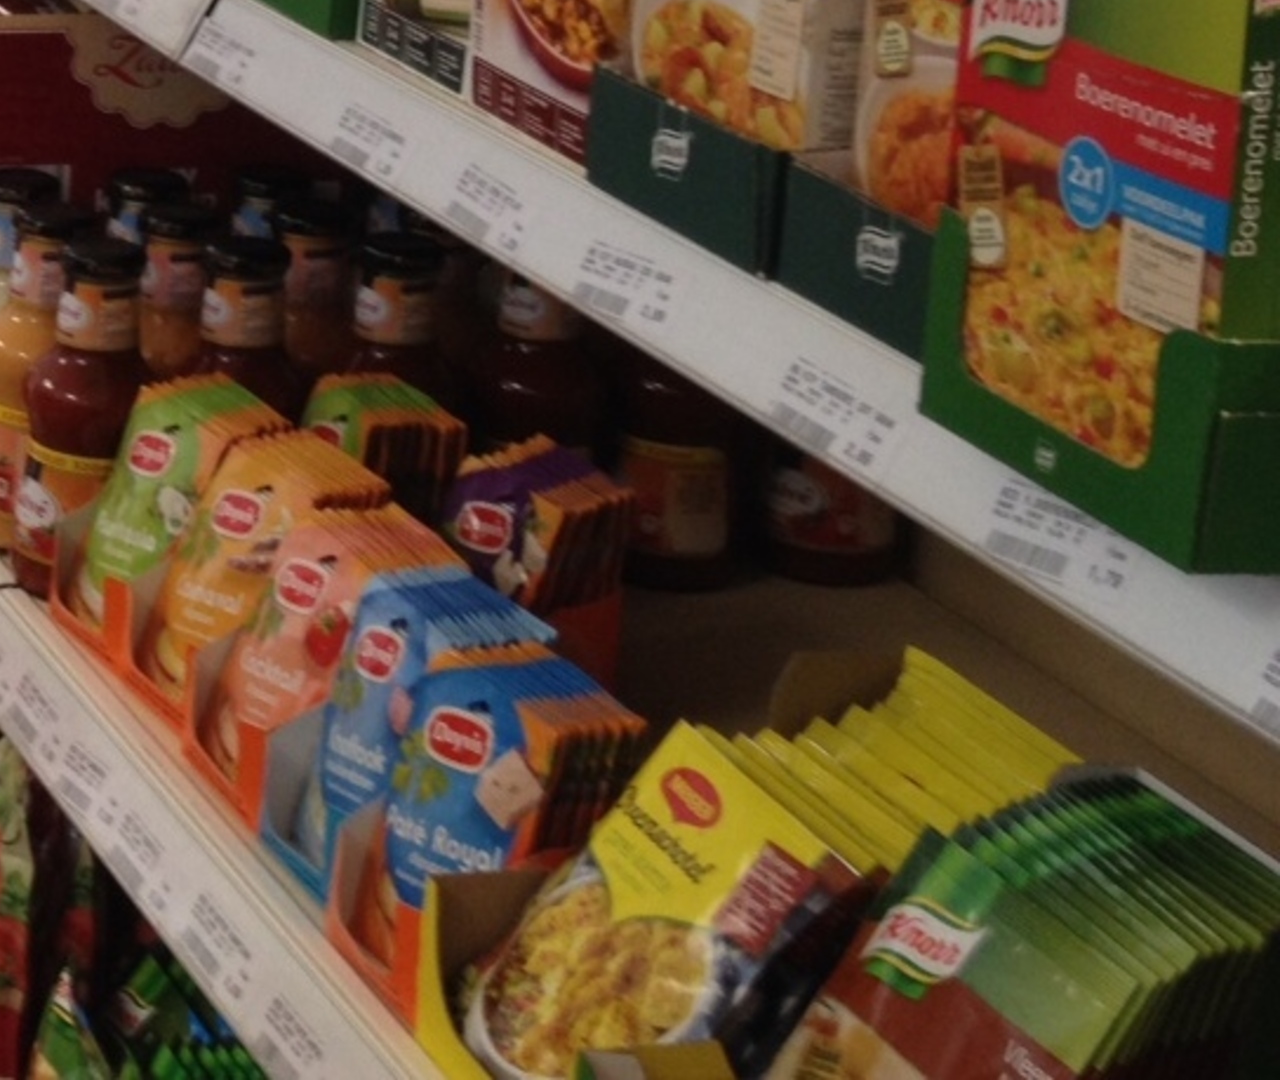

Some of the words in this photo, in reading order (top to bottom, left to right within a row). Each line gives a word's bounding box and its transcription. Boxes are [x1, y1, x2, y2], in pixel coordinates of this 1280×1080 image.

[1074, 71, 1218, 151] Boerenomelet
[1230, 60, 1276, 258] Boerenomelet
[883, 911, 962, 967] Knorr
